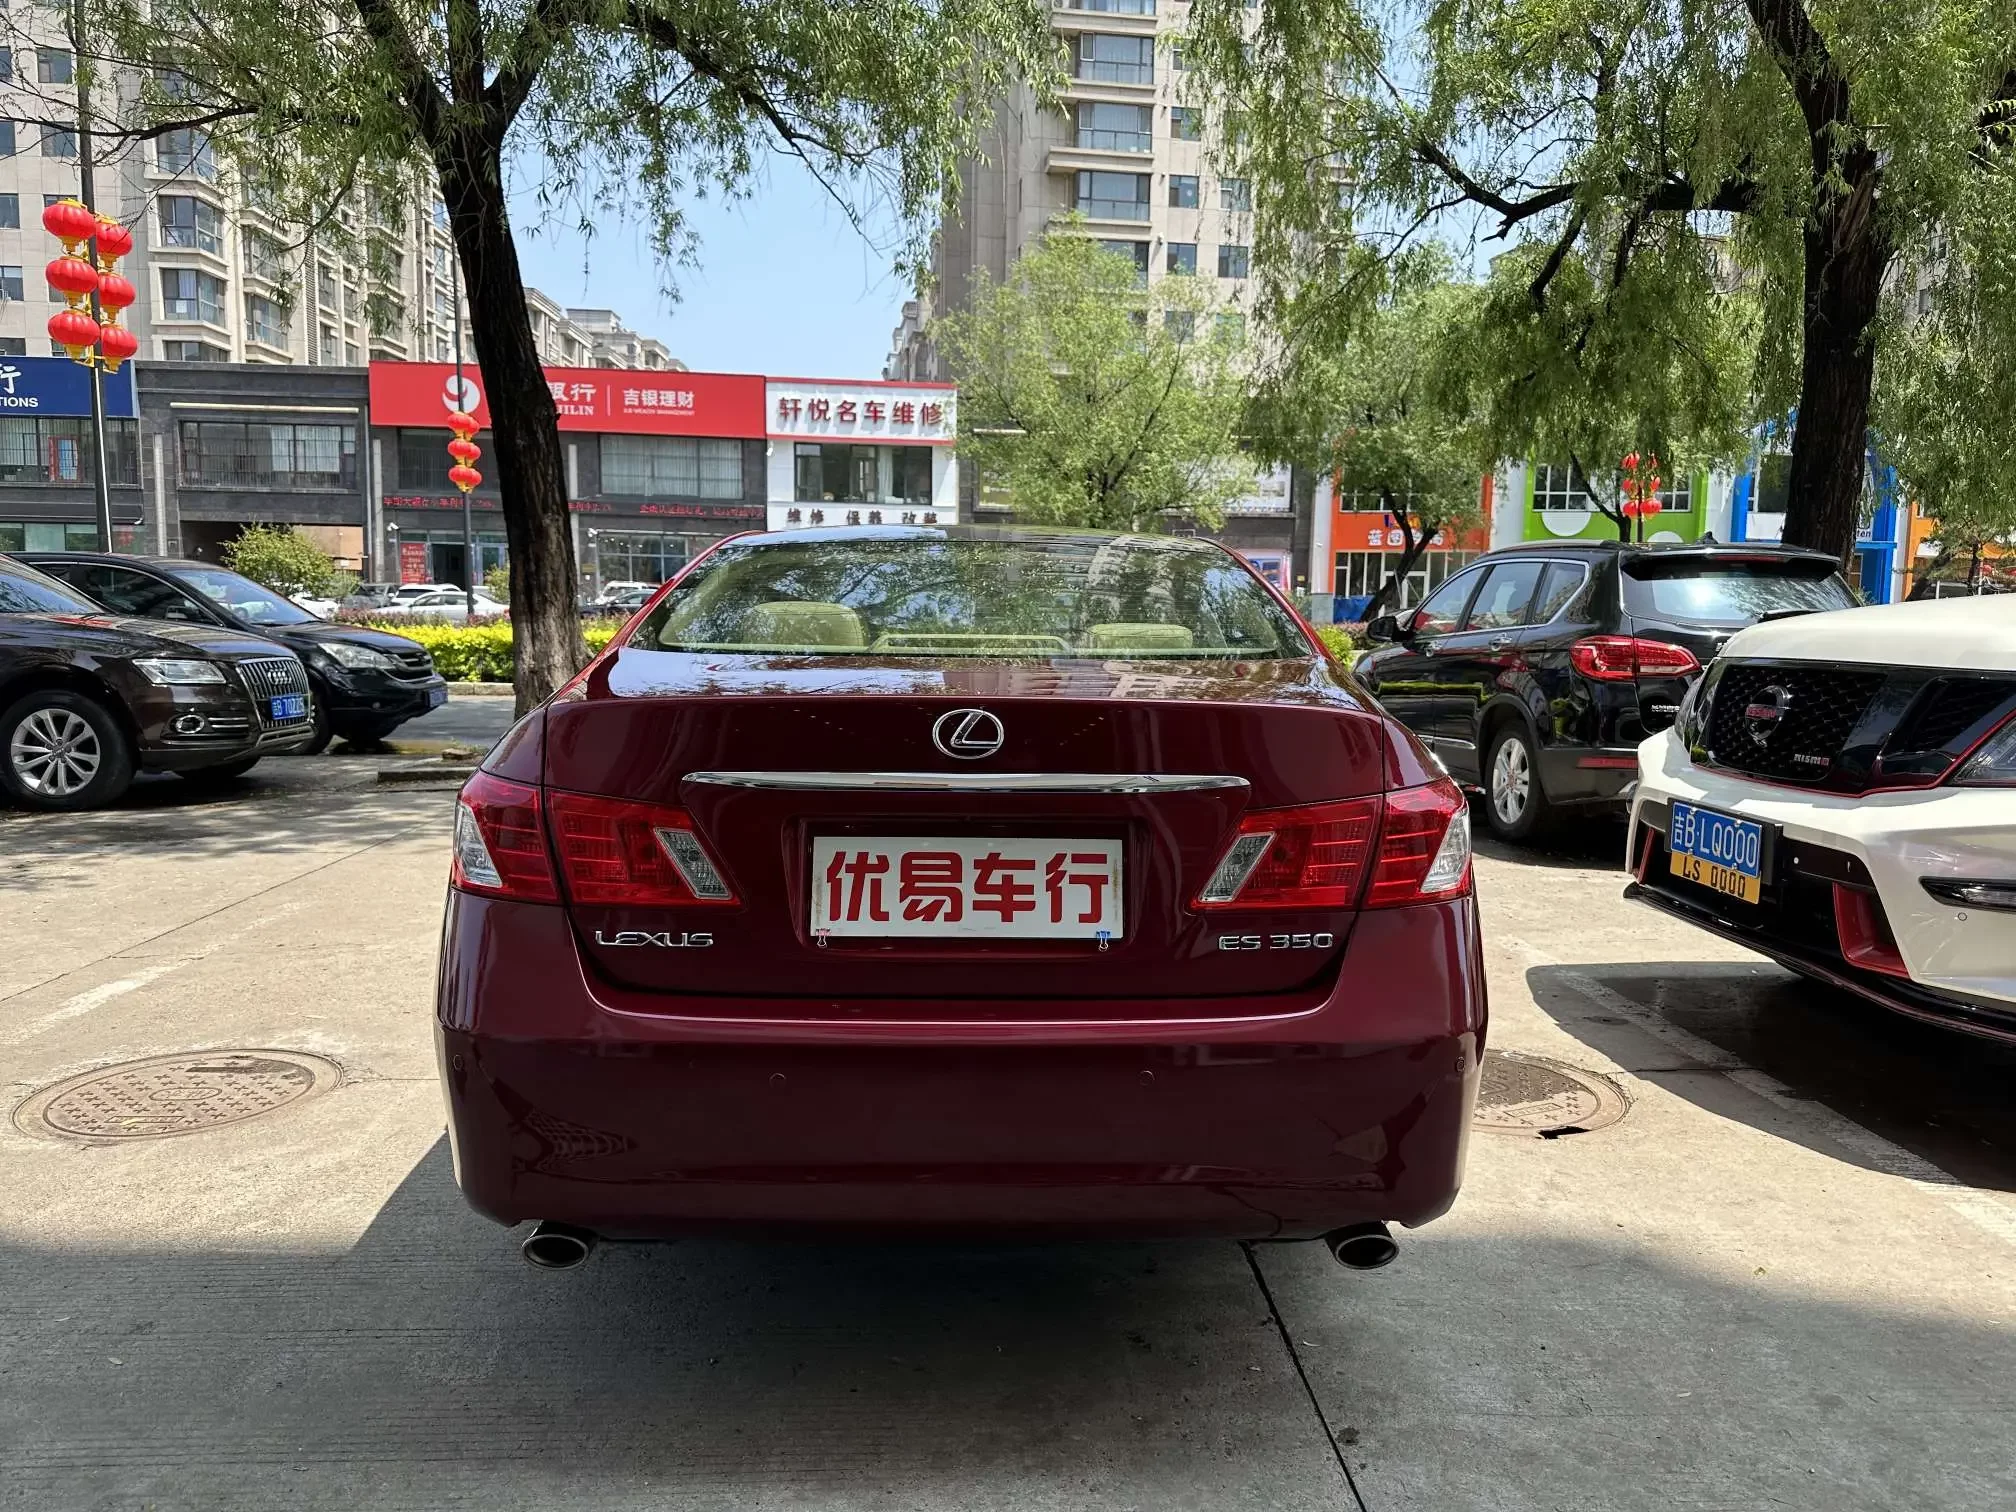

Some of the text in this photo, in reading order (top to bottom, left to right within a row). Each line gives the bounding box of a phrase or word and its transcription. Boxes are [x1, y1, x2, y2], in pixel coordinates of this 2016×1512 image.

[623, 388, 695, 408] 吉银理财
[779, 397, 944, 425] 轩悦名车维修
[1683, 855, 1701, 881] LS
[826, 851, 1109, 924] 优易车行
[595, 931, 714, 947] LEXUS
[1219, 933, 1333, 950] ES 350
